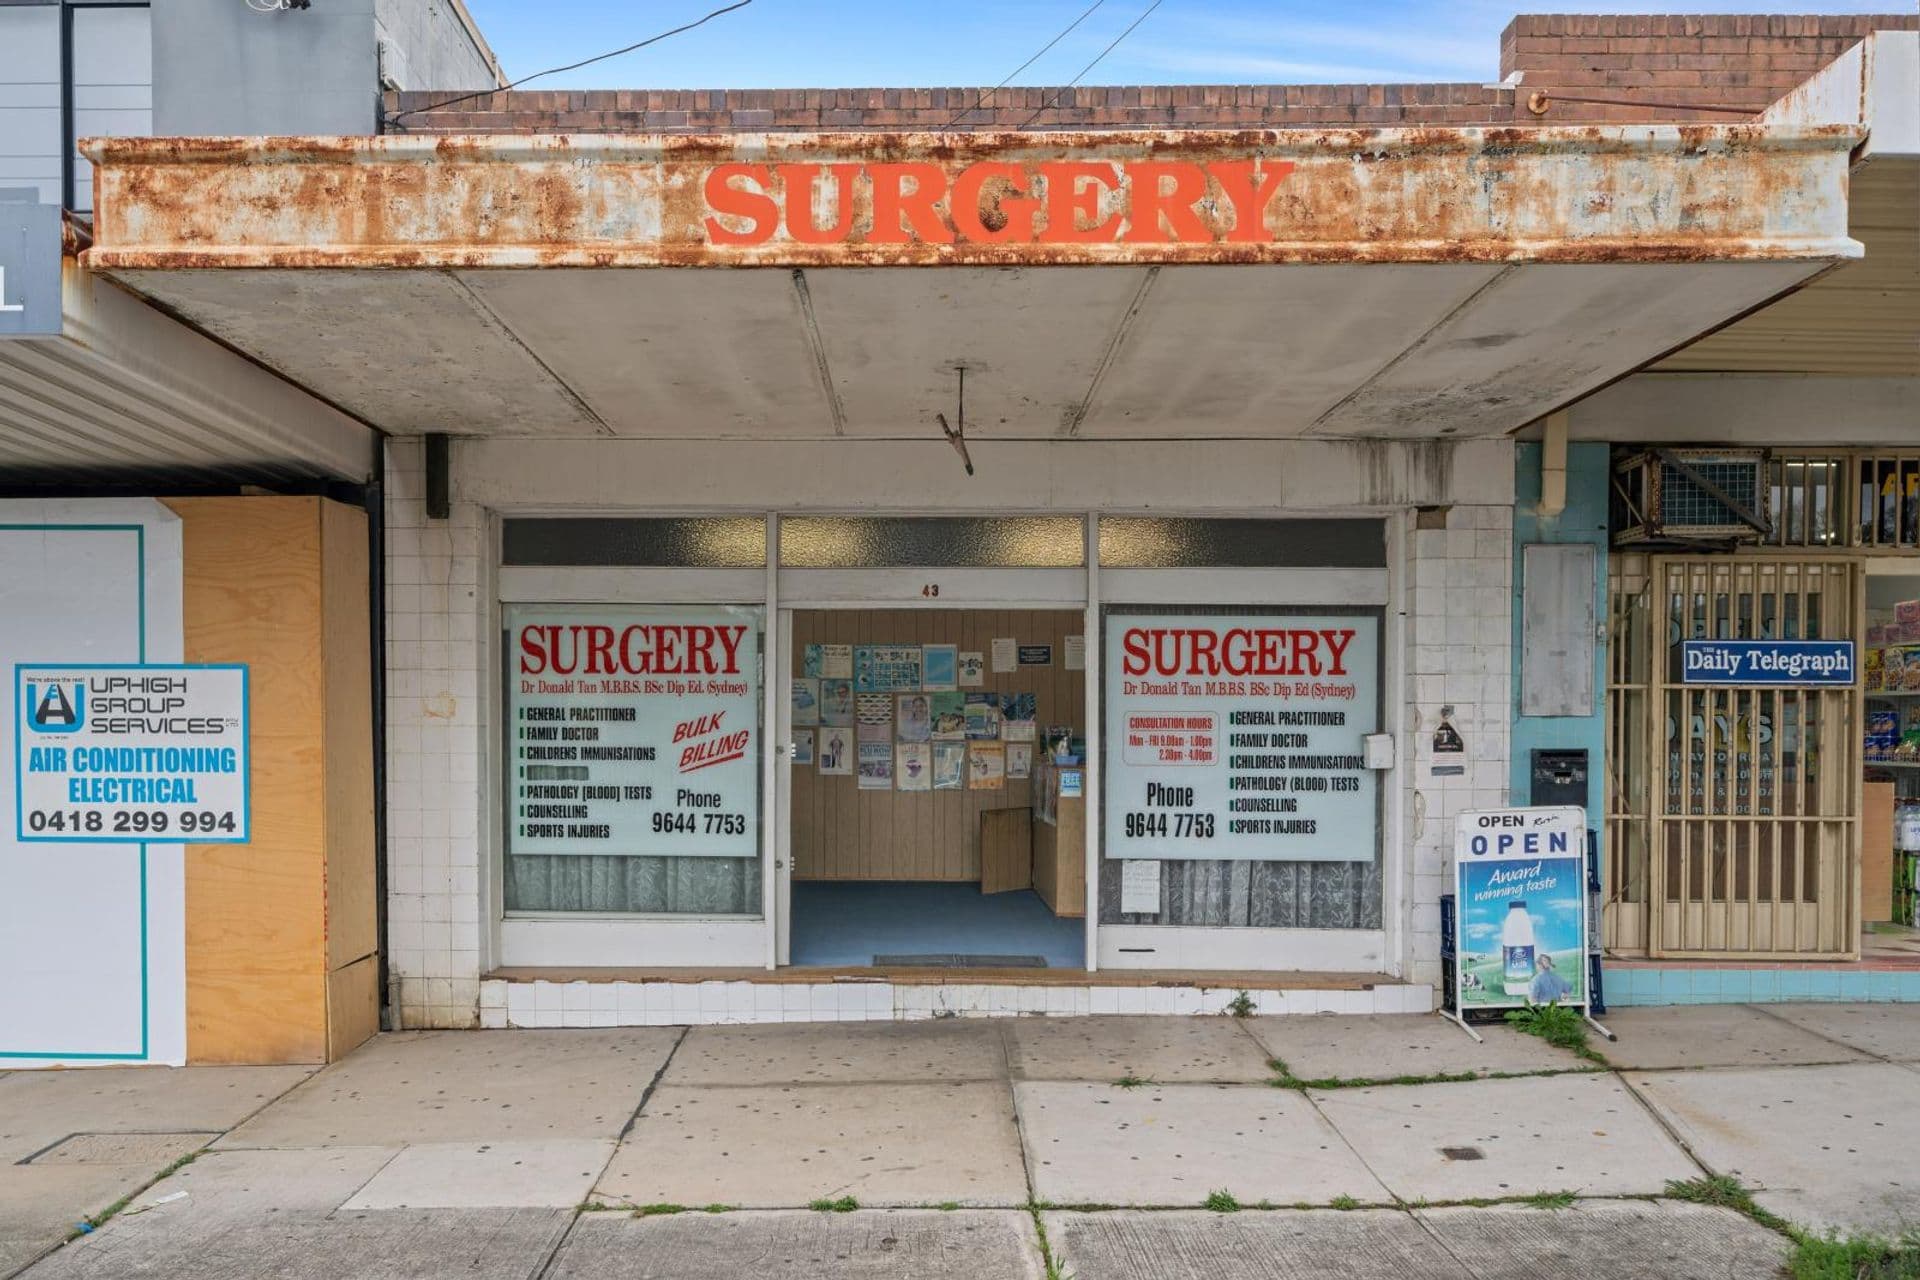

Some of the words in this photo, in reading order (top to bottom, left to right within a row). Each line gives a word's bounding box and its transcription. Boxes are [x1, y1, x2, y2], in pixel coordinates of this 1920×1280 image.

[703, 160, 1295, 246] SURGERY
[922, 584, 939, 597] 43
[520, 625, 748, 675] SURGERY
[1123, 628, 1356, 676] SURGERY
[1688, 649, 1742, 676] Daily
[1747, 649, 1849, 676] Telegraph
[91, 677, 187, 693] UPHIGH
[521, 681, 535, 694] Dr
[538, 681, 574, 694] Donald
[578, 681, 597, 694] Tan
[600, 681, 640, 694] M.B.B.S.
[644, 681, 663, 694] BSc
[667, 681, 685, 697] Dip
[707, 681, 748, 697] (Sydney)
[1124, 682, 1137, 695] Dr
[1141, 682, 1177, 695] Donald
[1181, 682, 1201, 695] Tan
[1250, 682, 1270, 696] BSc
[1273, 682, 1291, 700] Dip
[1311, 682, 1355, 700] (Sydney)
[91, 698, 184, 713] GROUP
[527, 707, 566, 721] GENERAL
[570, 708, 636, 721] PRACTITIONER
[1236, 712, 1275, 725] GENERAL
[1279, 712, 1345, 726] PRACTITIONER
[91, 718, 224, 734] SERVICES
[672, 710, 726, 743] BULK
[1129, 718, 1184, 729] CONSULTATION
[1187, 718, 1212, 729] HOURS
[527, 727, 558, 740] FAMILY
[562, 727, 599, 740] DOCTOR
[1235, 734, 1268, 747] FAMILY
[1271, 734, 1308, 748] DOCTOR
[527, 747, 577, 760] CHILDRENS
[581, 747, 656, 760] IMMUNISATIONS
[680, 730, 749, 767] BILLING
[29, 747, 67, 772] AIR
[72, 747, 236, 773] CONDITIONING
[1236, 755, 1286, 769] CHILDRENS
[1288, 755, 1365, 770] IMMUNISATIONS
[69, 778, 198, 803] ELECTRICAL
[527, 785, 579, 799] PATHOLOGY
[624, 786, 652, 799] TESTS
[1235, 777, 1287, 791] PATHOLOGY
[1290, 777, 1328, 793] (BLOOD)
[1331, 777, 1359, 791] TESTS
[677, 789, 721, 807] Phone
[1147, 782, 1193, 807] Phone
[527, 805, 588, 818] COUNSELLING
[1235, 798, 1297, 812] COUNSELLING
[29, 810, 103, 832] 0418
[113, 811, 168, 833] 299
[180, 811, 236, 833] 994
[653, 812, 696, 833] 9644
[704, 814, 745, 834] 7753
[1126, 813, 1167, 837] 9644
[1174, 813, 1214, 838] 7753
[1235, 820, 1271, 834] SPORTS
[1274, 820, 1316, 834] INJURIES
[1478, 815, 1524, 828] OPEN
[527, 824, 564, 837] SPORTS
[568, 825, 610, 838] INJURIES
[1471, 832, 1566, 855] OPEN
[1488, 861, 1542, 886] Award
[1475, 884, 1523, 902] winning
[1526, 877, 1557, 891] taste
